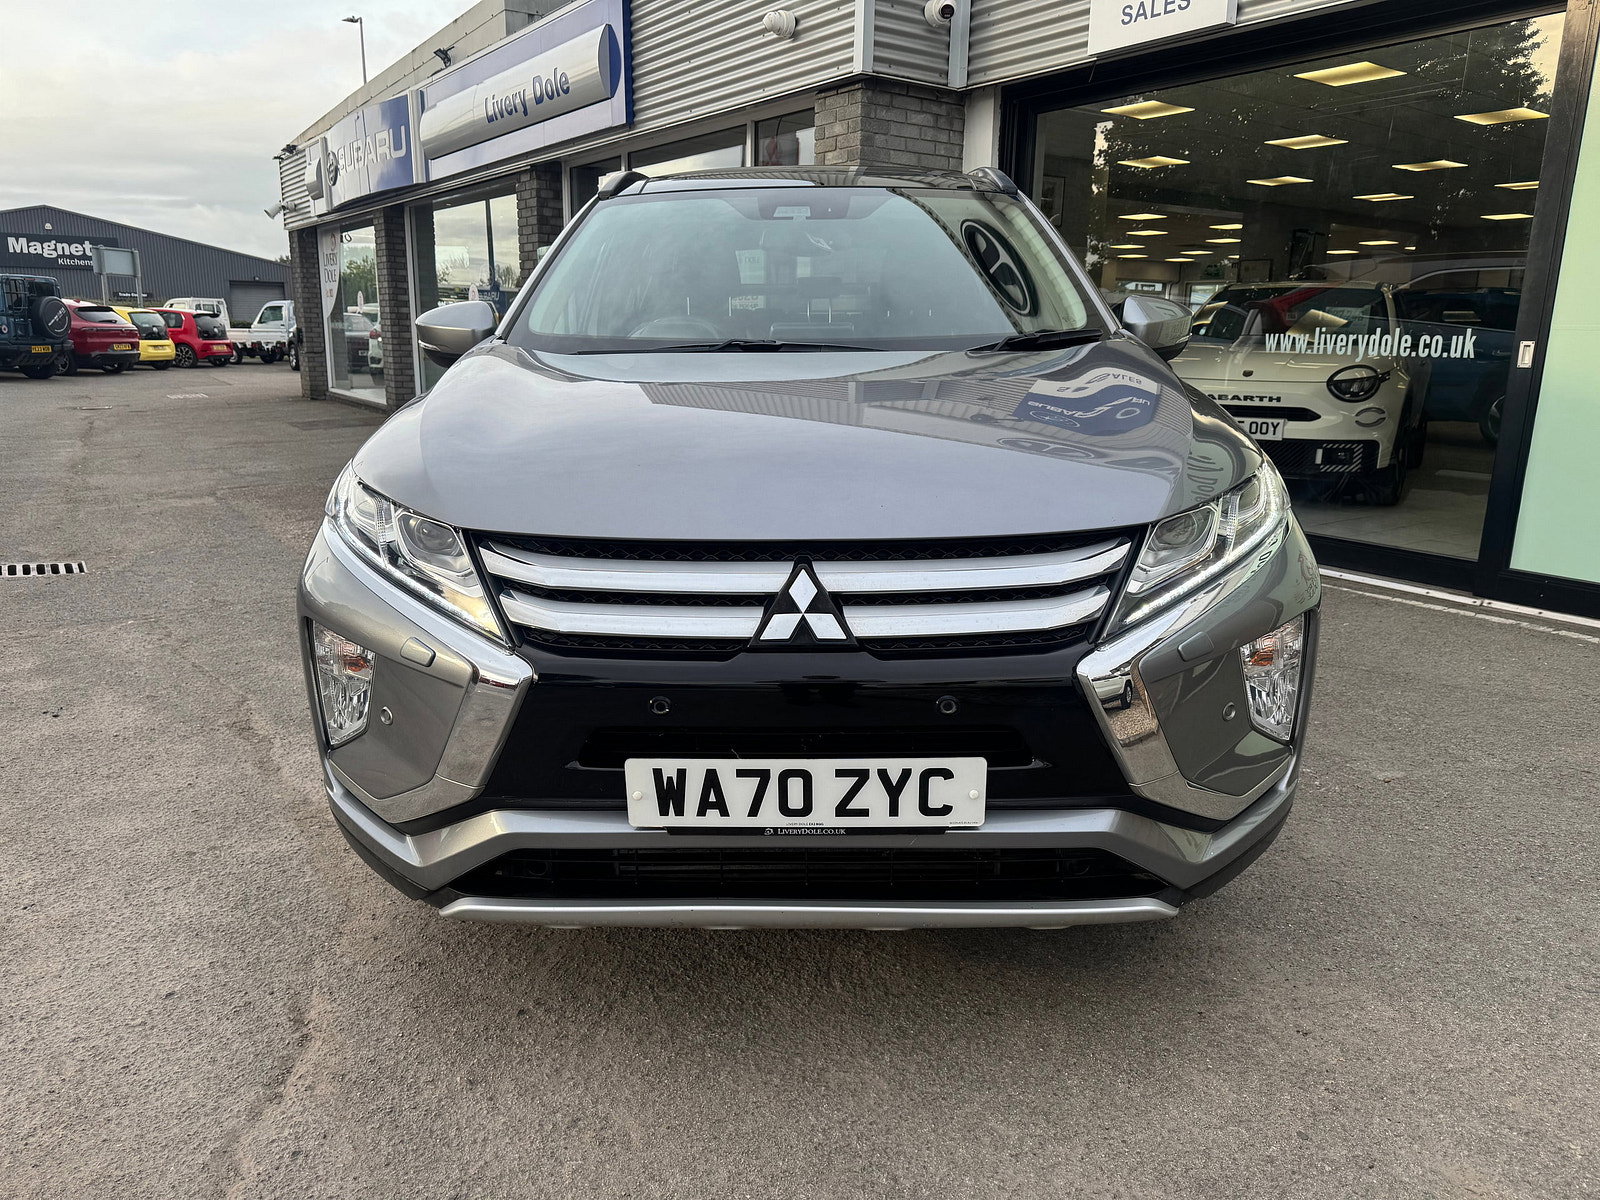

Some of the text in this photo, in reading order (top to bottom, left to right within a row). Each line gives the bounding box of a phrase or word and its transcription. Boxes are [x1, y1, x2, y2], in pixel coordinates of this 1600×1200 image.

[484, 67, 570, 124] Livery Dole
[337, 125, 407, 176] SUBARU
[7, 236, 93, 258] Magnet
[58, 258, 93, 266] Kitchens
[1265, 327, 1477, 362] www.liverydole.co.uk
[1207, 394, 1282, 402] ABARTH
[652, 767, 955, 818] WA70 ZYC
